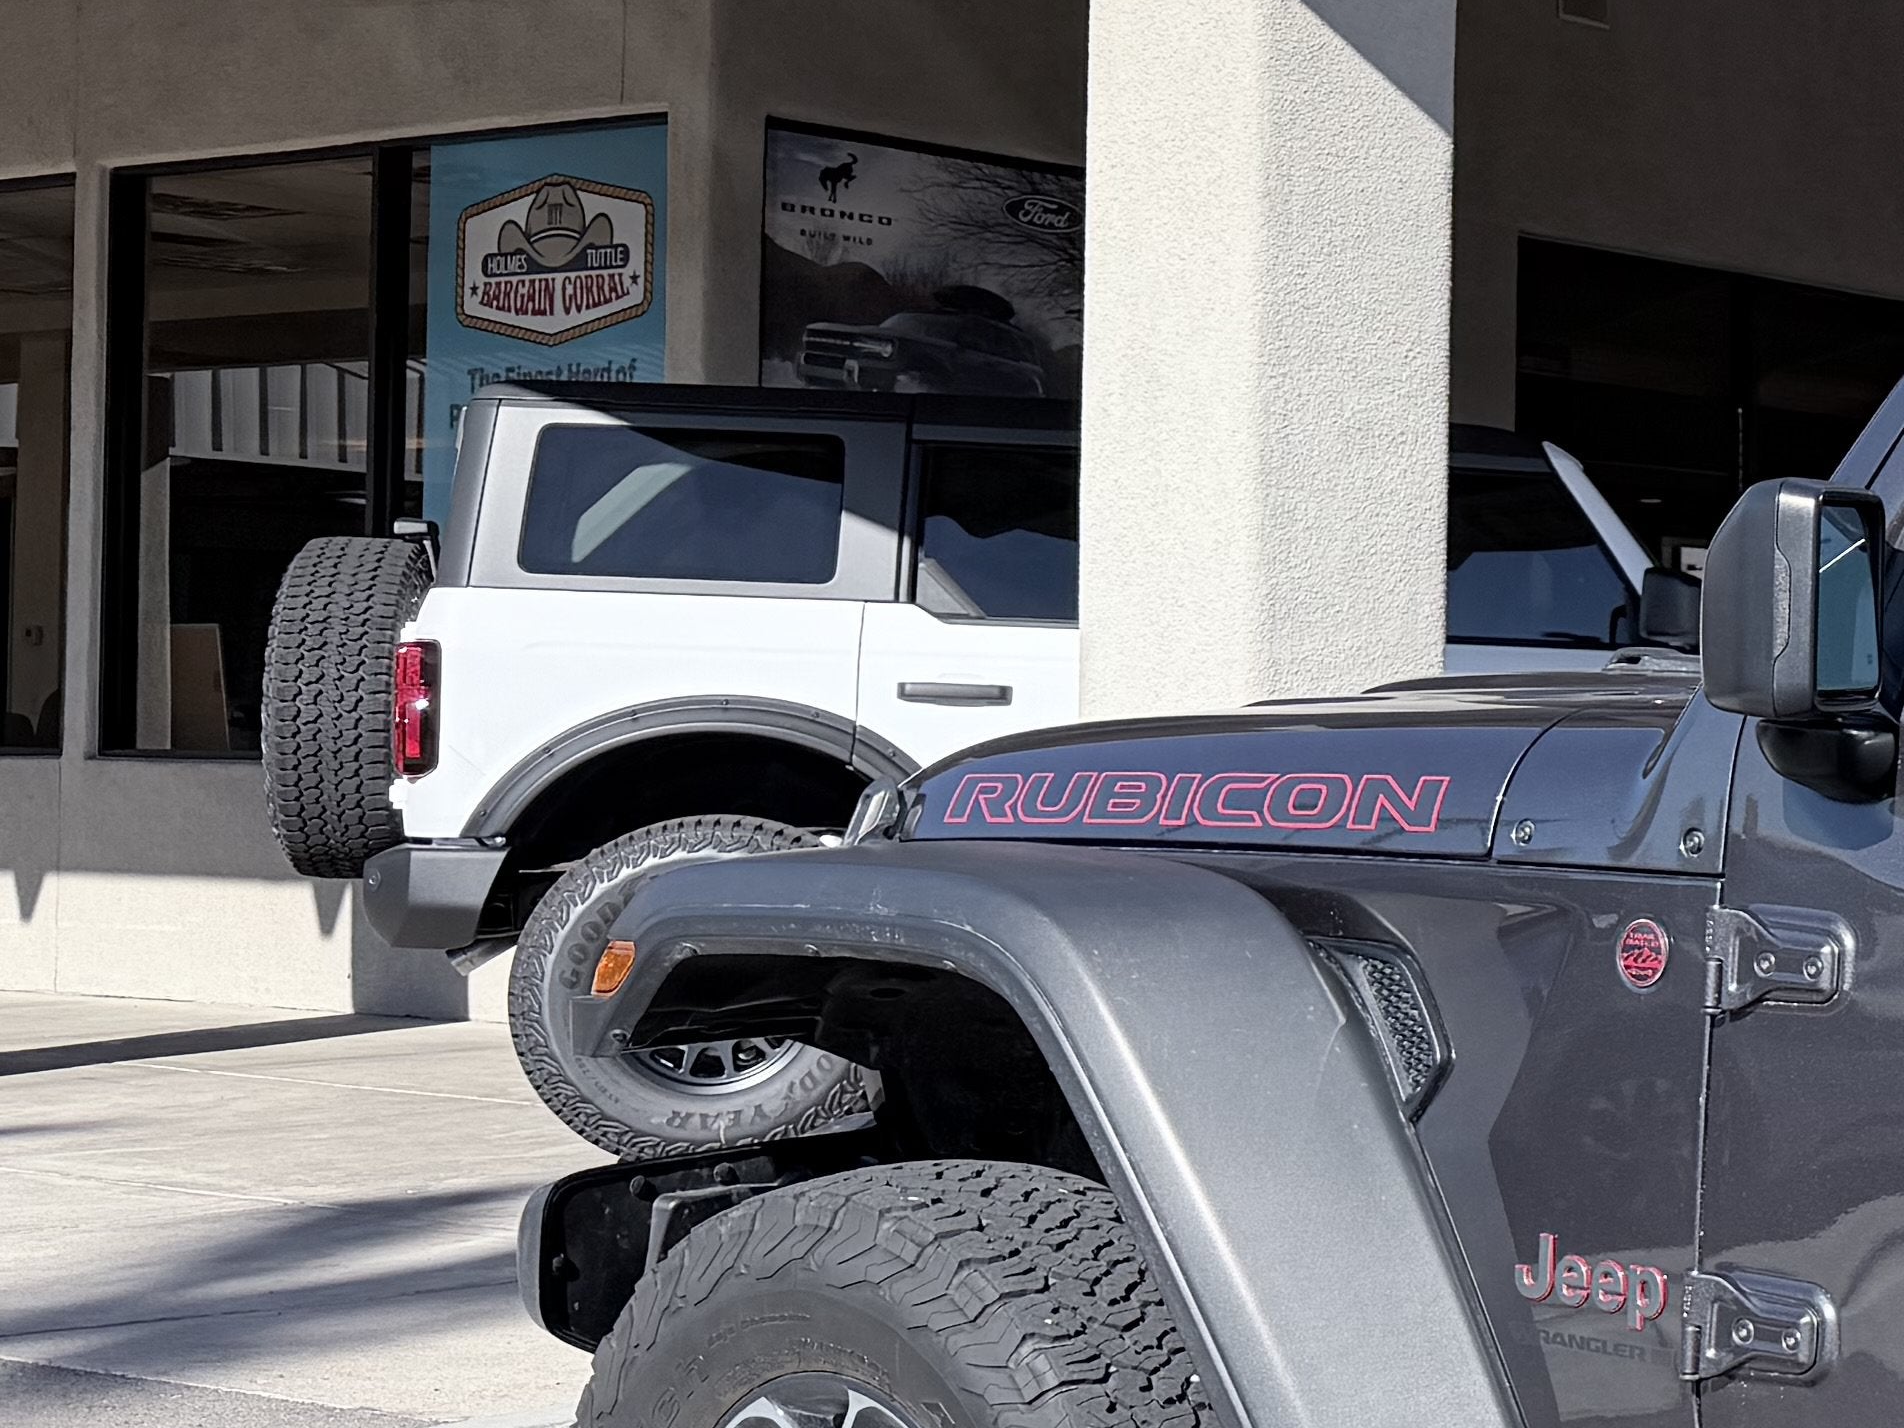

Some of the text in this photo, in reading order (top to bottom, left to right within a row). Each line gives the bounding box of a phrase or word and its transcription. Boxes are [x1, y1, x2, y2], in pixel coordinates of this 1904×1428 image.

[780, 201, 894, 228] BRONCO
[1018, 198, 1071, 229] Ford
[487, 247, 625, 273] HOLMES TUTTLE
[479, 272, 630, 316] BARGAIN CORRAL
[943, 771, 1451, 835] RUBICON
[1514, 1232, 1669, 1332] Jeep
[1536, 1328, 1649, 1363] RANGLER
